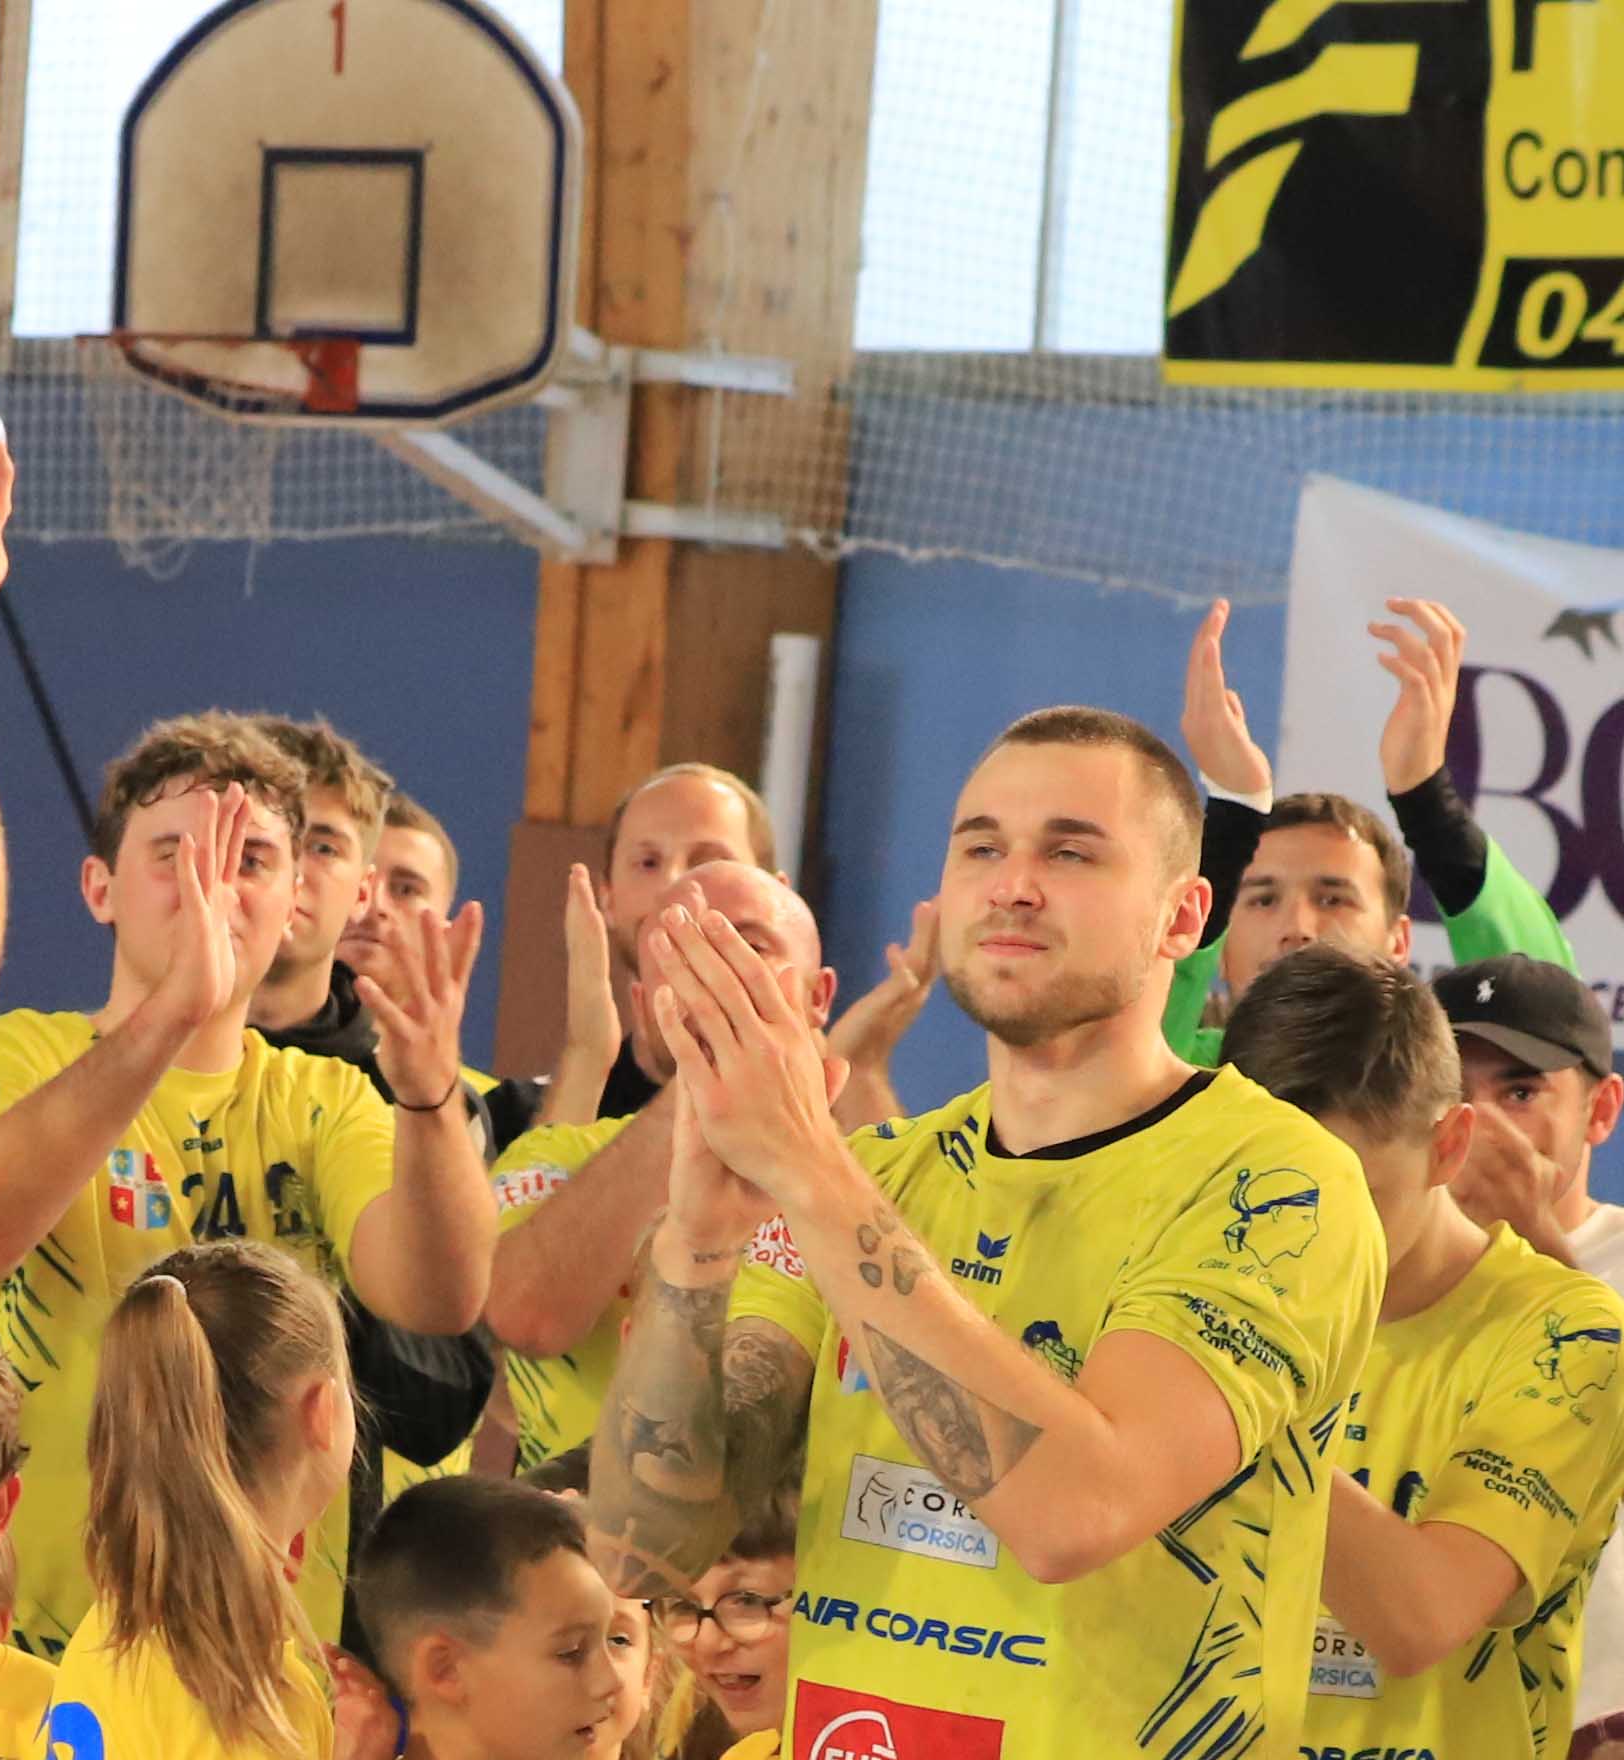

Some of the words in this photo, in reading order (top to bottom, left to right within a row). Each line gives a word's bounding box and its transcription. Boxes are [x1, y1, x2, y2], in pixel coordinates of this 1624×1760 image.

[951, 1256, 1003, 1286] erim
[904, 1487, 978, 1521] COR
[897, 1519, 987, 1555] CORSICA
[792, 1590, 860, 1632] AIR
[866, 1607, 1047, 1667] CORSIC
[1313, 1635, 1366, 1657] ORS
